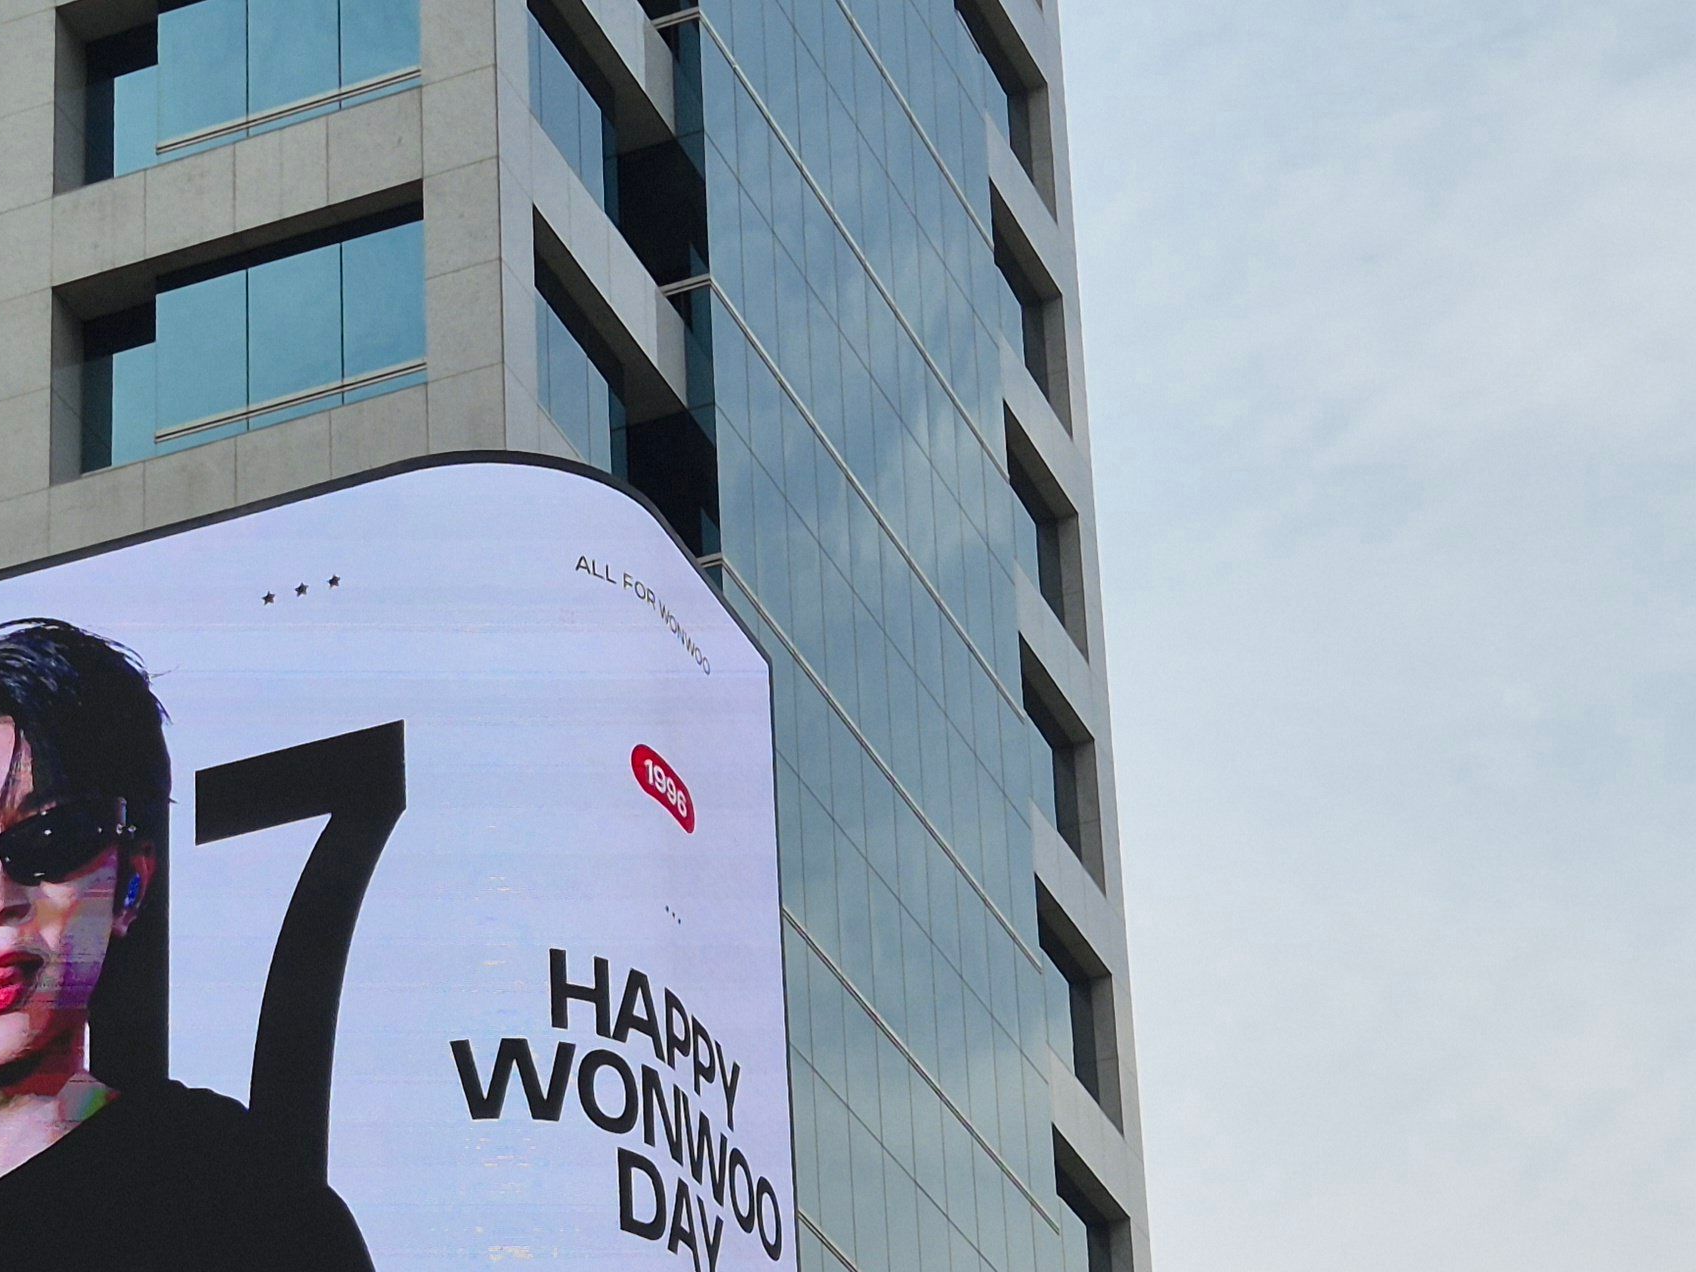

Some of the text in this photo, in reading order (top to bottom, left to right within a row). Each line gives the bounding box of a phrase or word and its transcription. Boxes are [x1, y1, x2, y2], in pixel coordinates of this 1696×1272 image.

[575, 555, 711, 675] ALL FOR WONWOO
[644, 759, 688, 818] 1996
[549, 948, 741, 1132] HAPPY
[450, 1037, 783, 1261] WONWOO
